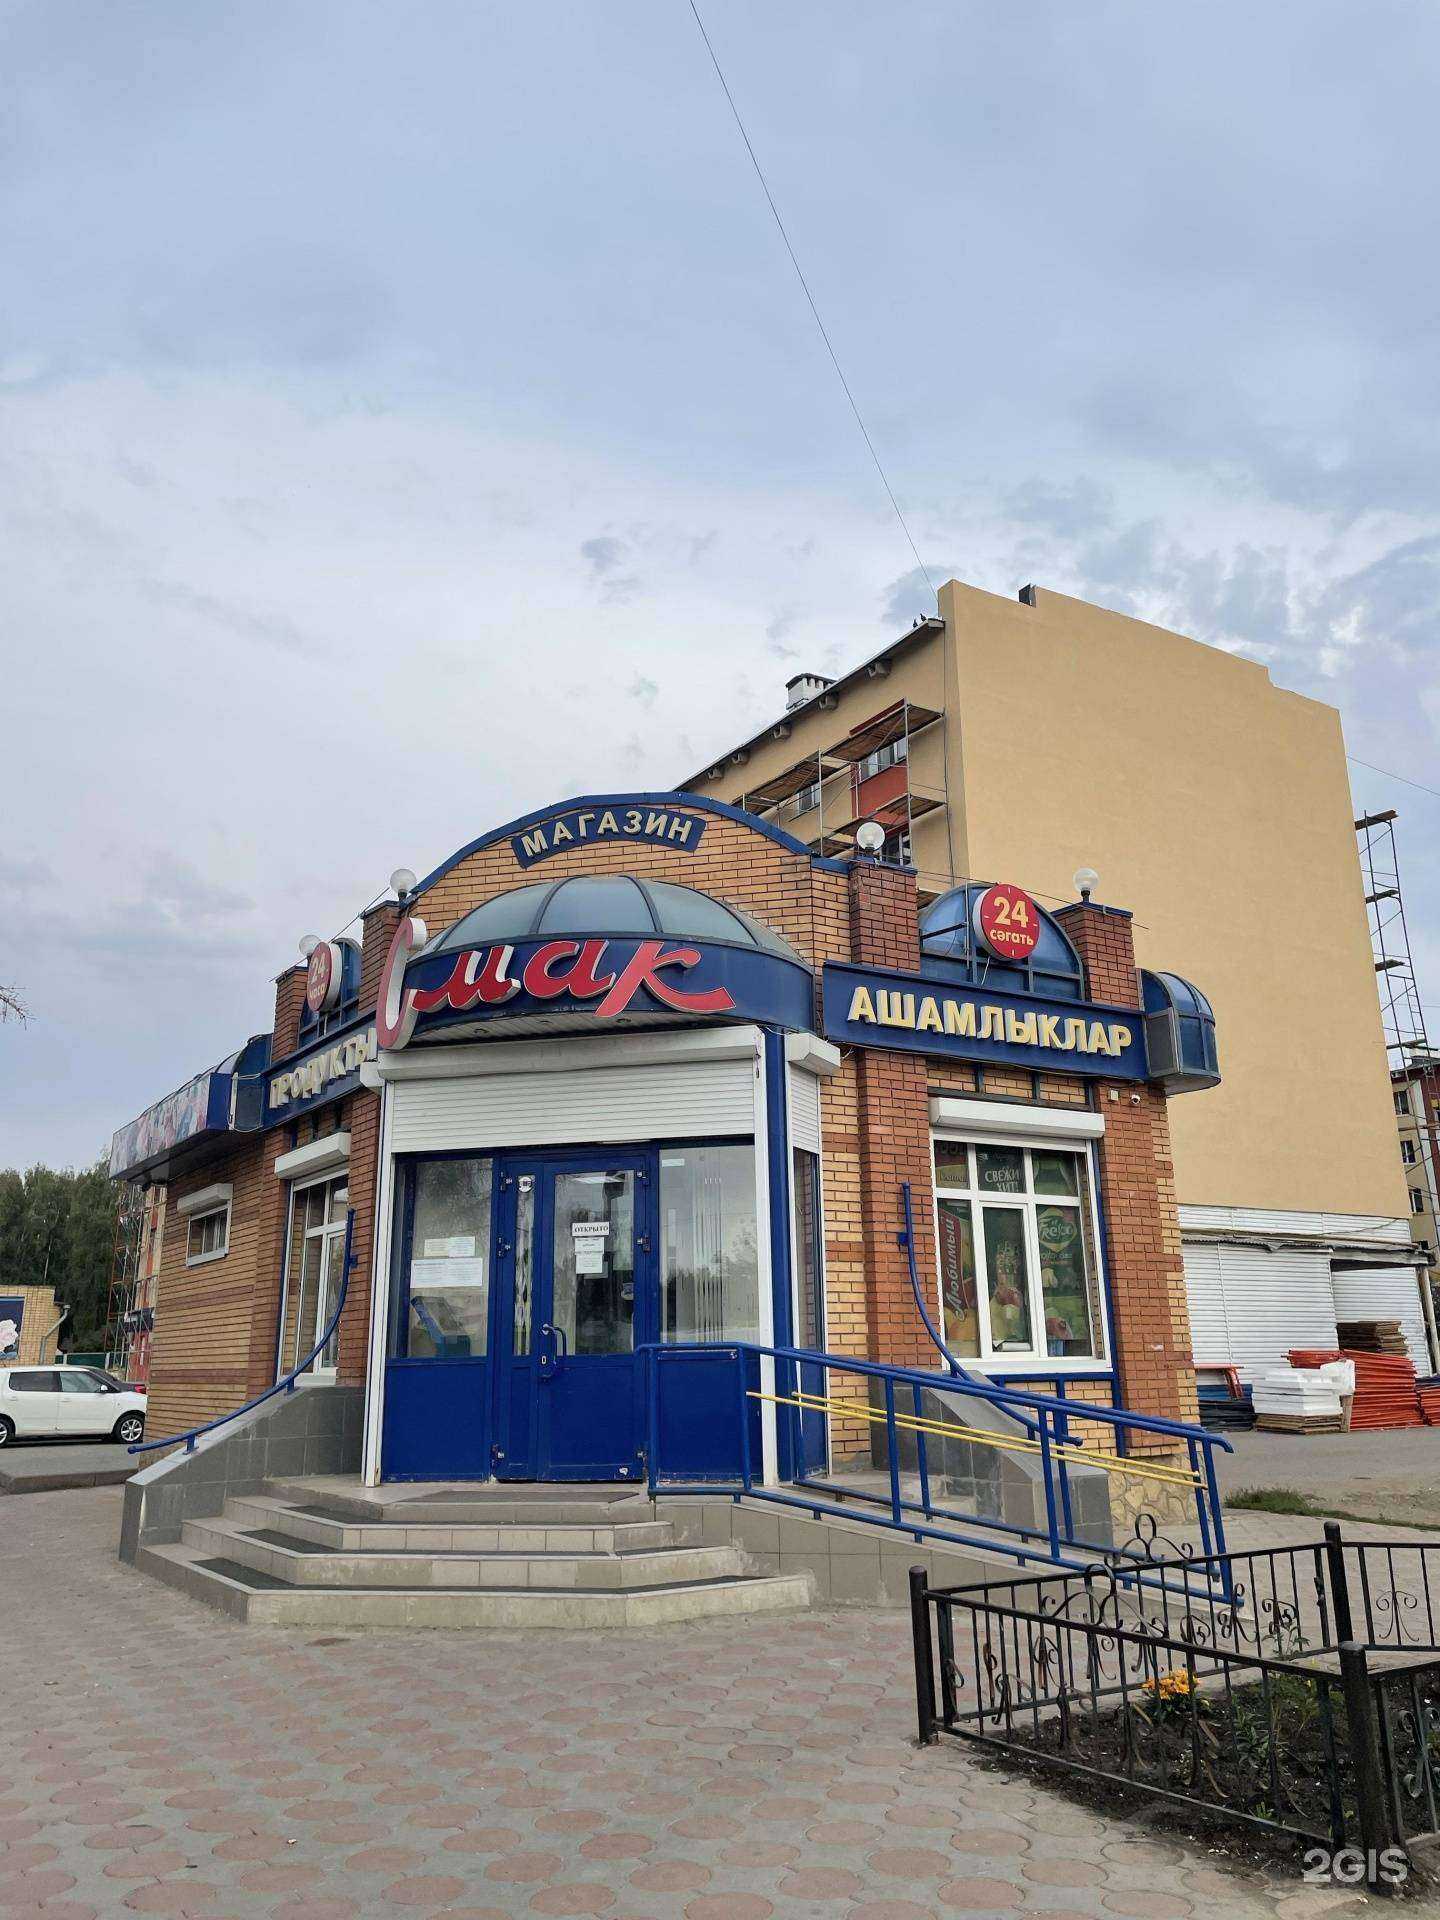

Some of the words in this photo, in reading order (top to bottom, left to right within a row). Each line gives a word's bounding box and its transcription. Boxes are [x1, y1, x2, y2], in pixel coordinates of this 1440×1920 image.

[521, 809, 694, 858] МАГАЗИН
[993, 896, 1029, 929] 24
[309, 951, 327, 985] 24
[847, 985, 1132, 1058] АШАМЛЫКЛАР
[574, 1225, 609, 1233] ОТКРЫТО
